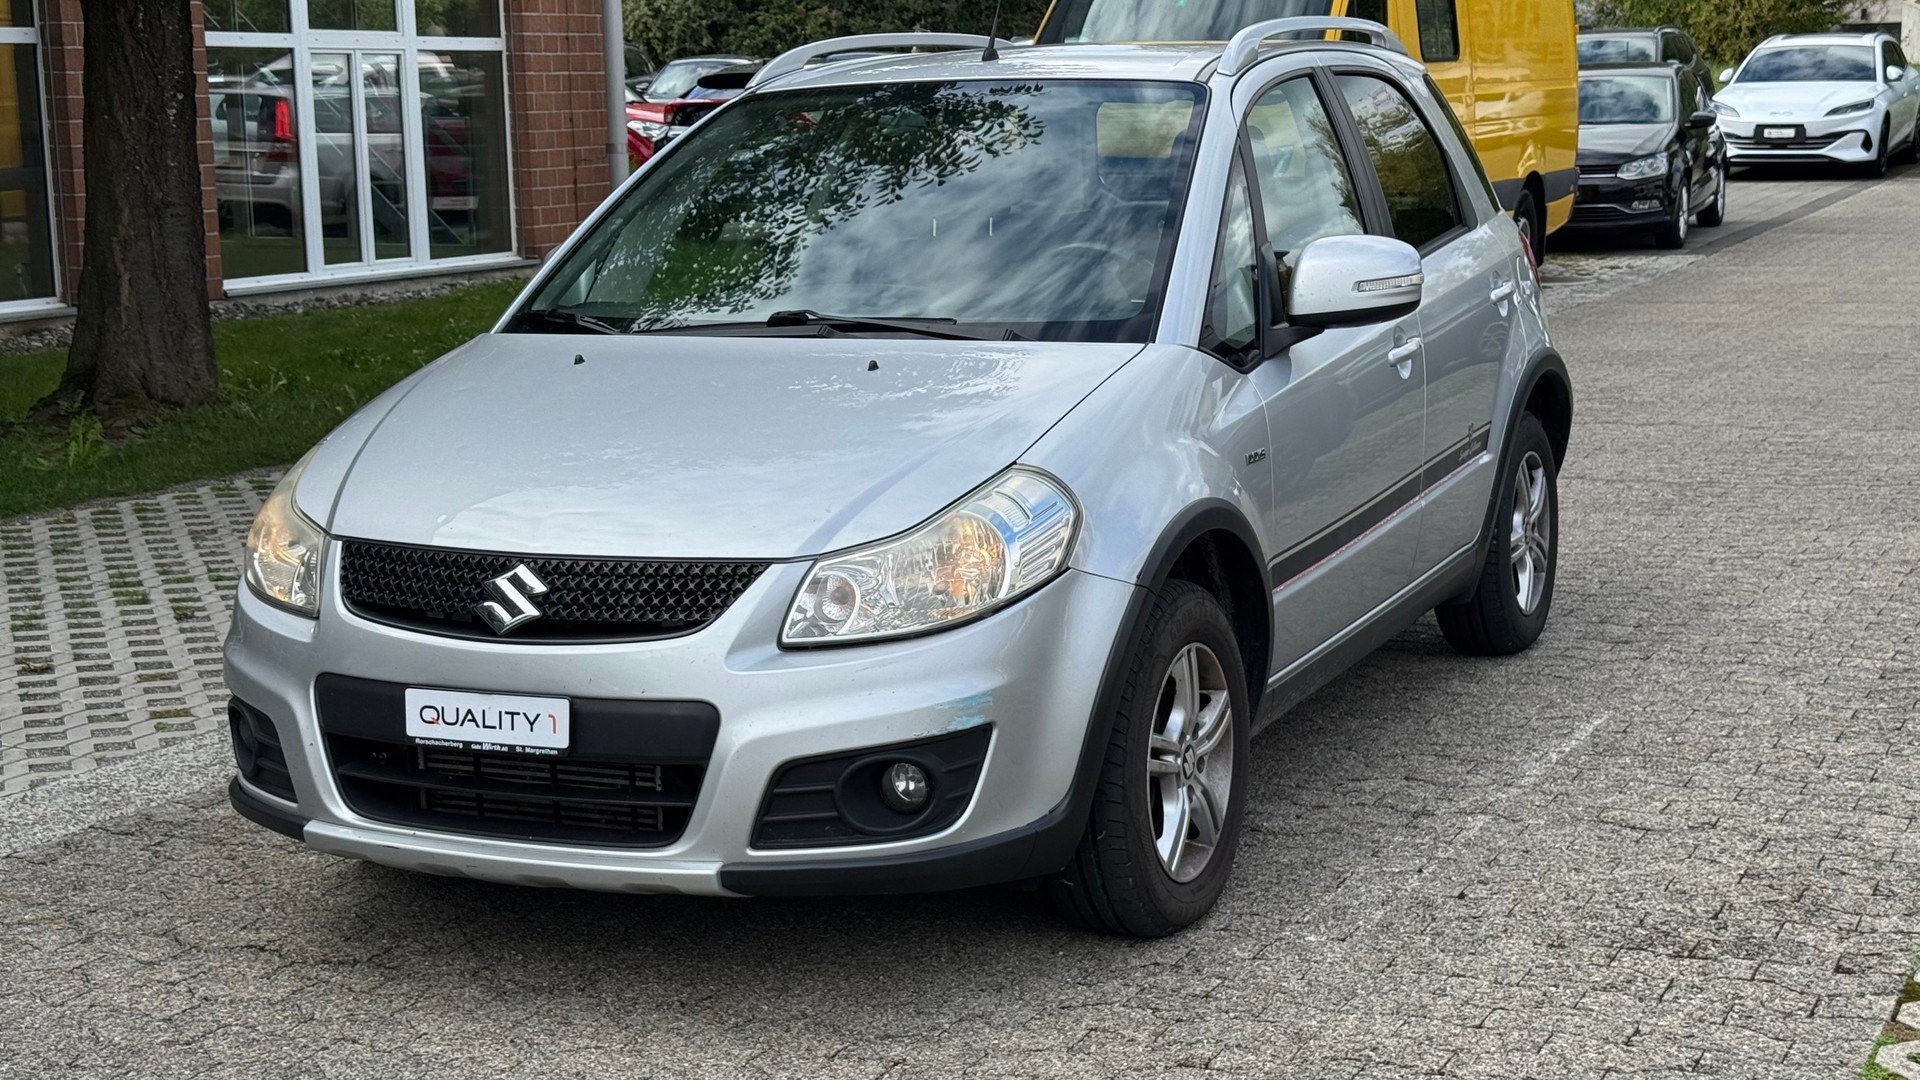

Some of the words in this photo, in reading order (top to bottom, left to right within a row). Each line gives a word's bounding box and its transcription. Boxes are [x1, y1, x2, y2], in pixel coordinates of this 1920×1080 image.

[420, 704, 541, 733] QUALITY
[548, 713, 557, 735] 1
[482, 742, 500, 752] Wirth
[525, 746, 558, 755] Margrethen
